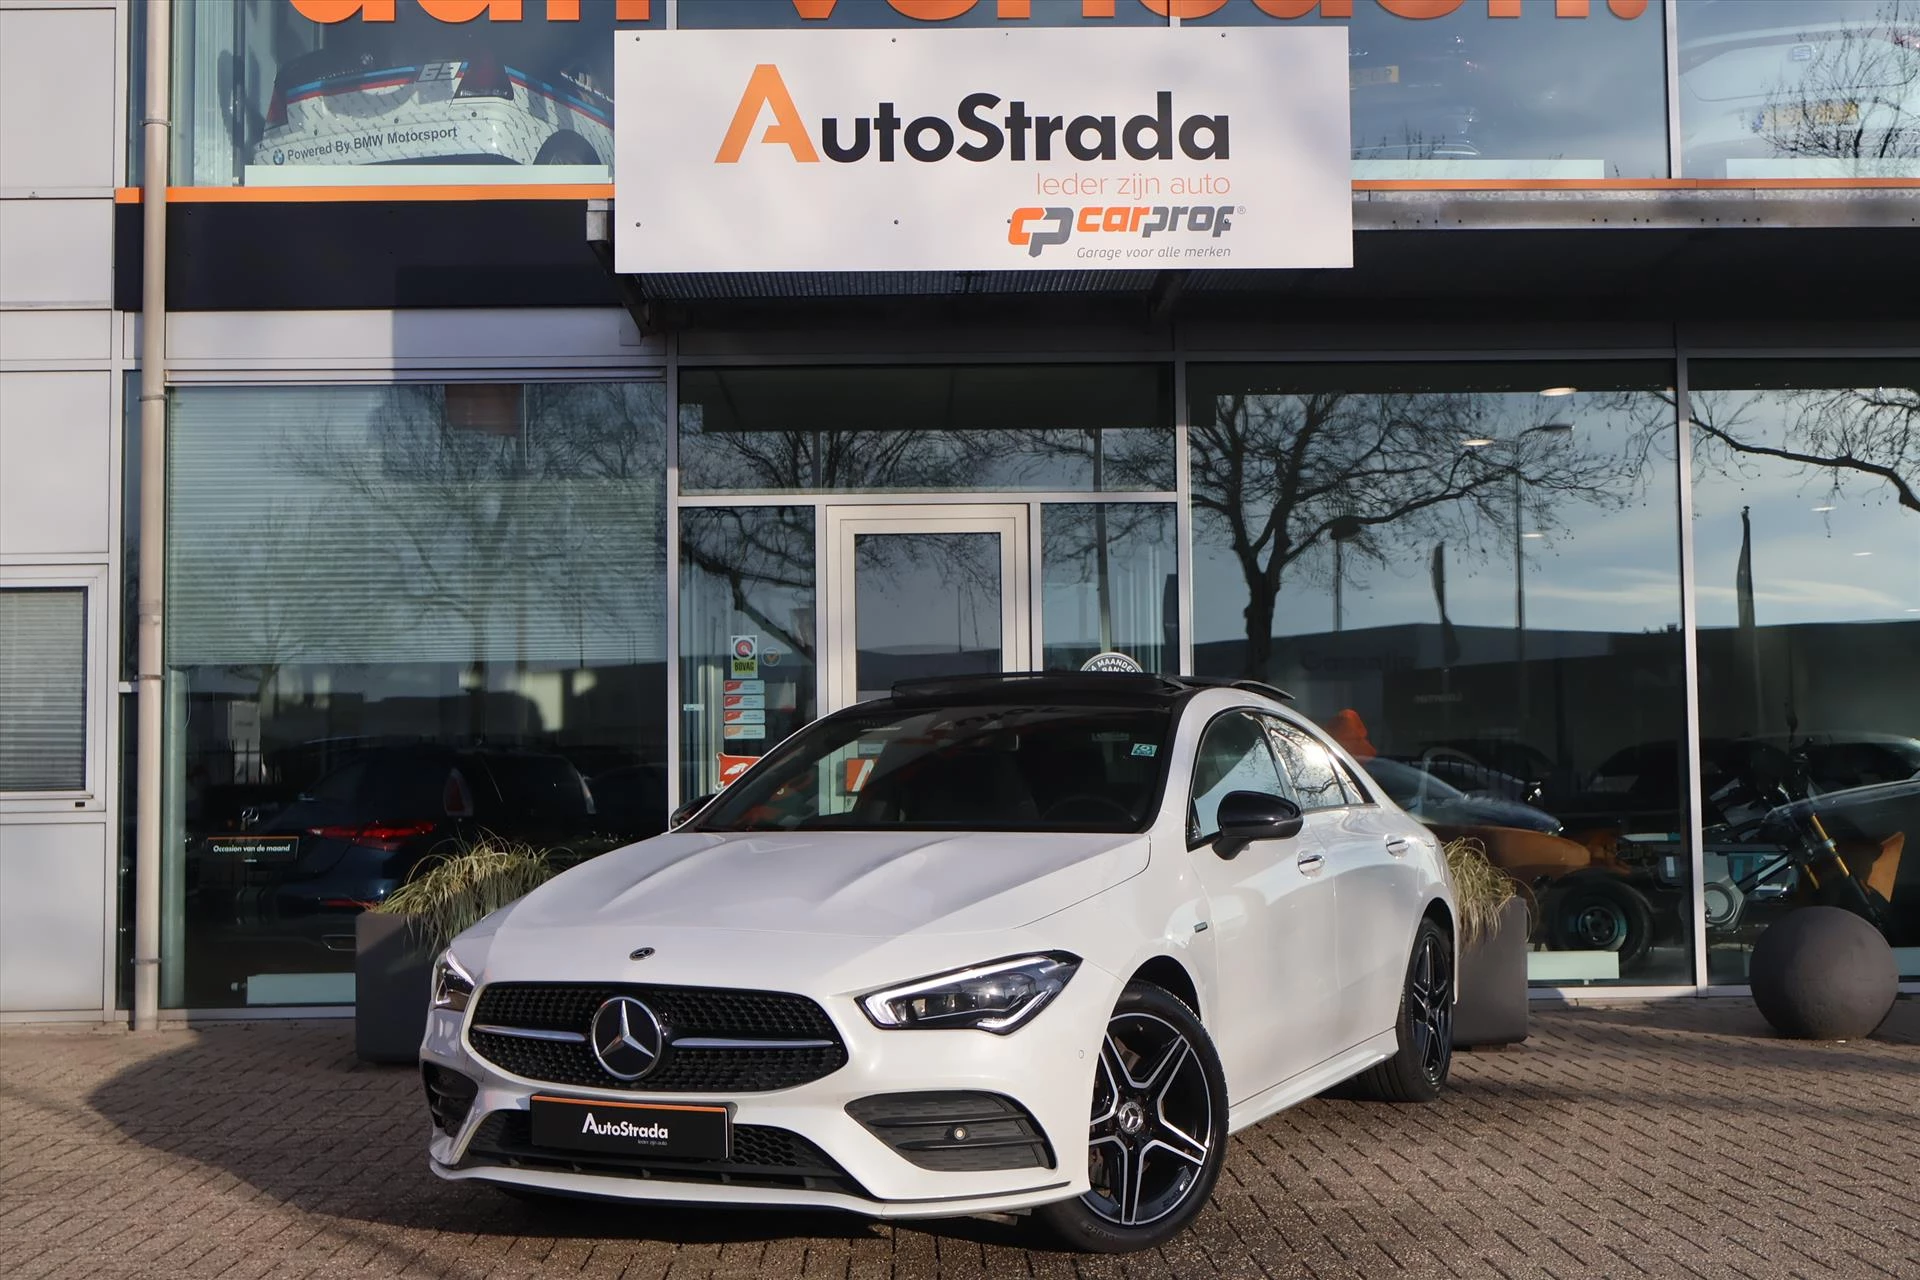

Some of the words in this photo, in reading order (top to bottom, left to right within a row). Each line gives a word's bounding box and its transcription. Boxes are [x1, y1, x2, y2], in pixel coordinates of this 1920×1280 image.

[417, 62, 462, 81] 69
[714, 63, 1230, 163] AutoStrada
[287, 143, 332, 161] Powered
[335, 140, 350, 154] By
[353, 134, 384, 149] BMW
[387, 127, 458, 145] Motorsport
[1036, 172, 1108, 195] Ieder
[1117, 173, 1160, 200] zijn
[1170, 173, 1231, 195] auto
[1077, 247, 1122, 260] Garage
[1126, 248, 1157, 258] voor
[1158, 246, 1181, 258] alle
[1185, 246, 1231, 257] merken
[734, 661, 755, 672] BOVAG
[256, 844, 266, 852] de
[266, 844, 291, 852] maand
[582, 1112, 669, 1139] AutoStrada
